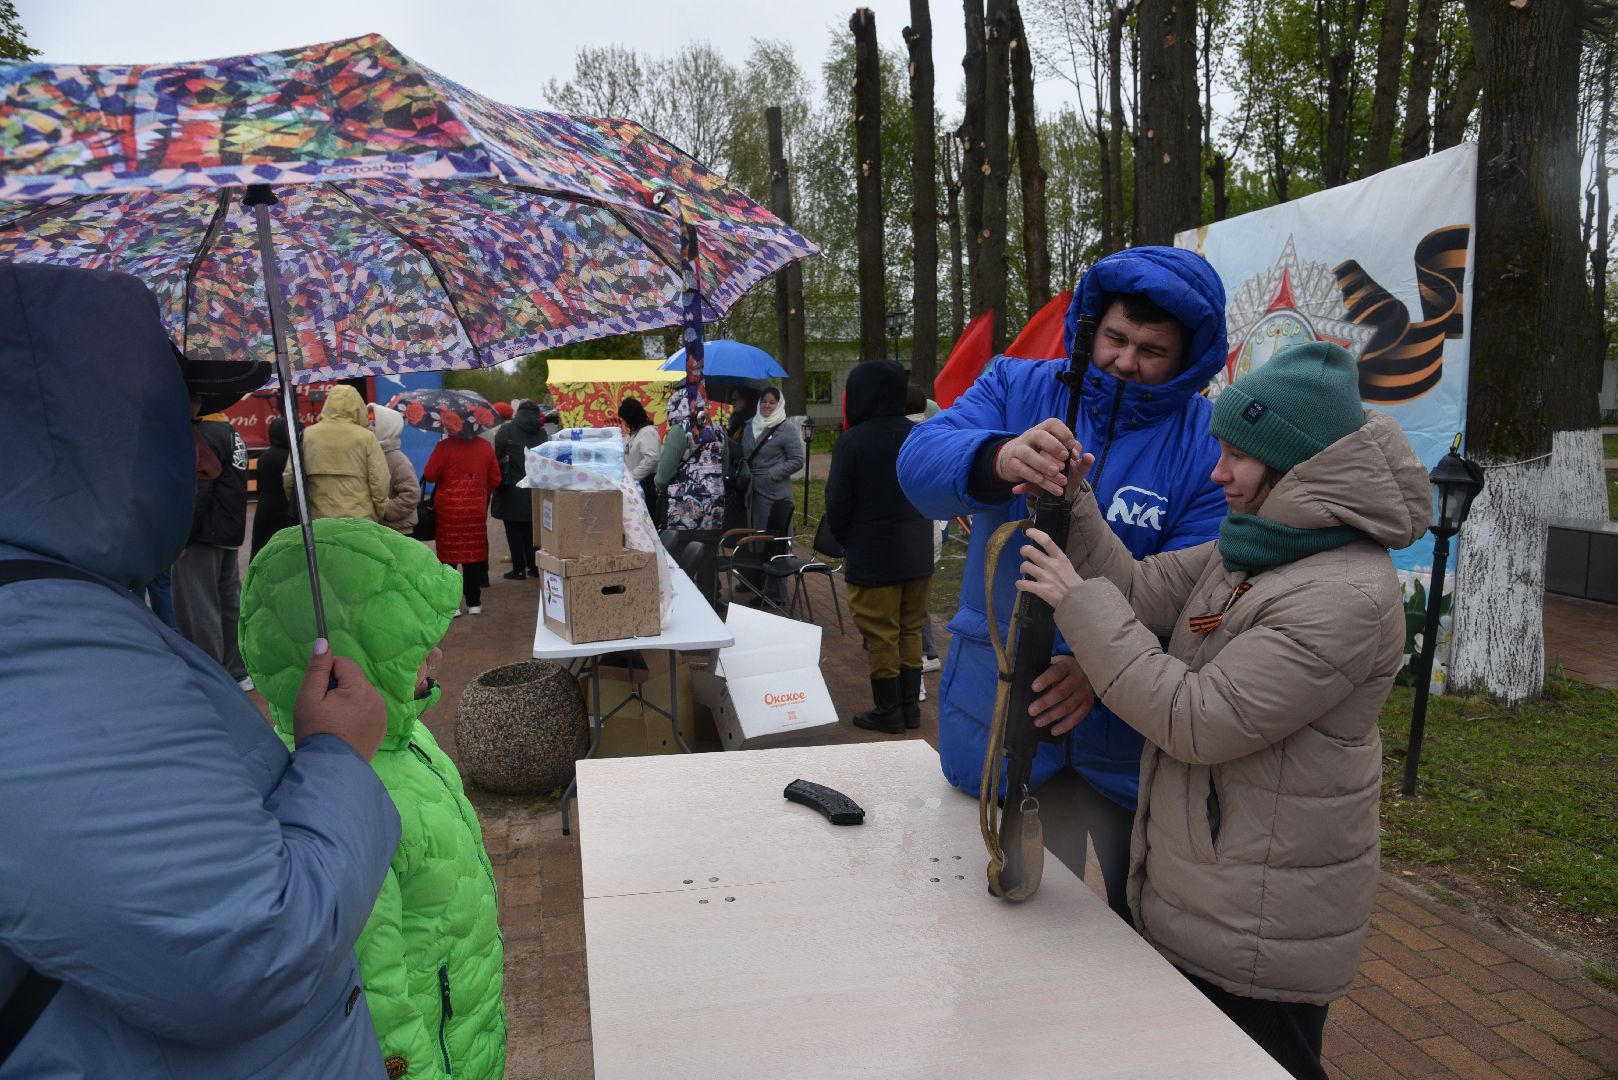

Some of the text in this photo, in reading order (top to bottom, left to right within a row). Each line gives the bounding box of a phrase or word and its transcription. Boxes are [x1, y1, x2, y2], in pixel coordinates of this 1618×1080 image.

[323, 162, 415, 175] Goroshek
[1255, 319, 1301, 345] СССР
[764, 691, 805, 705] Окское
